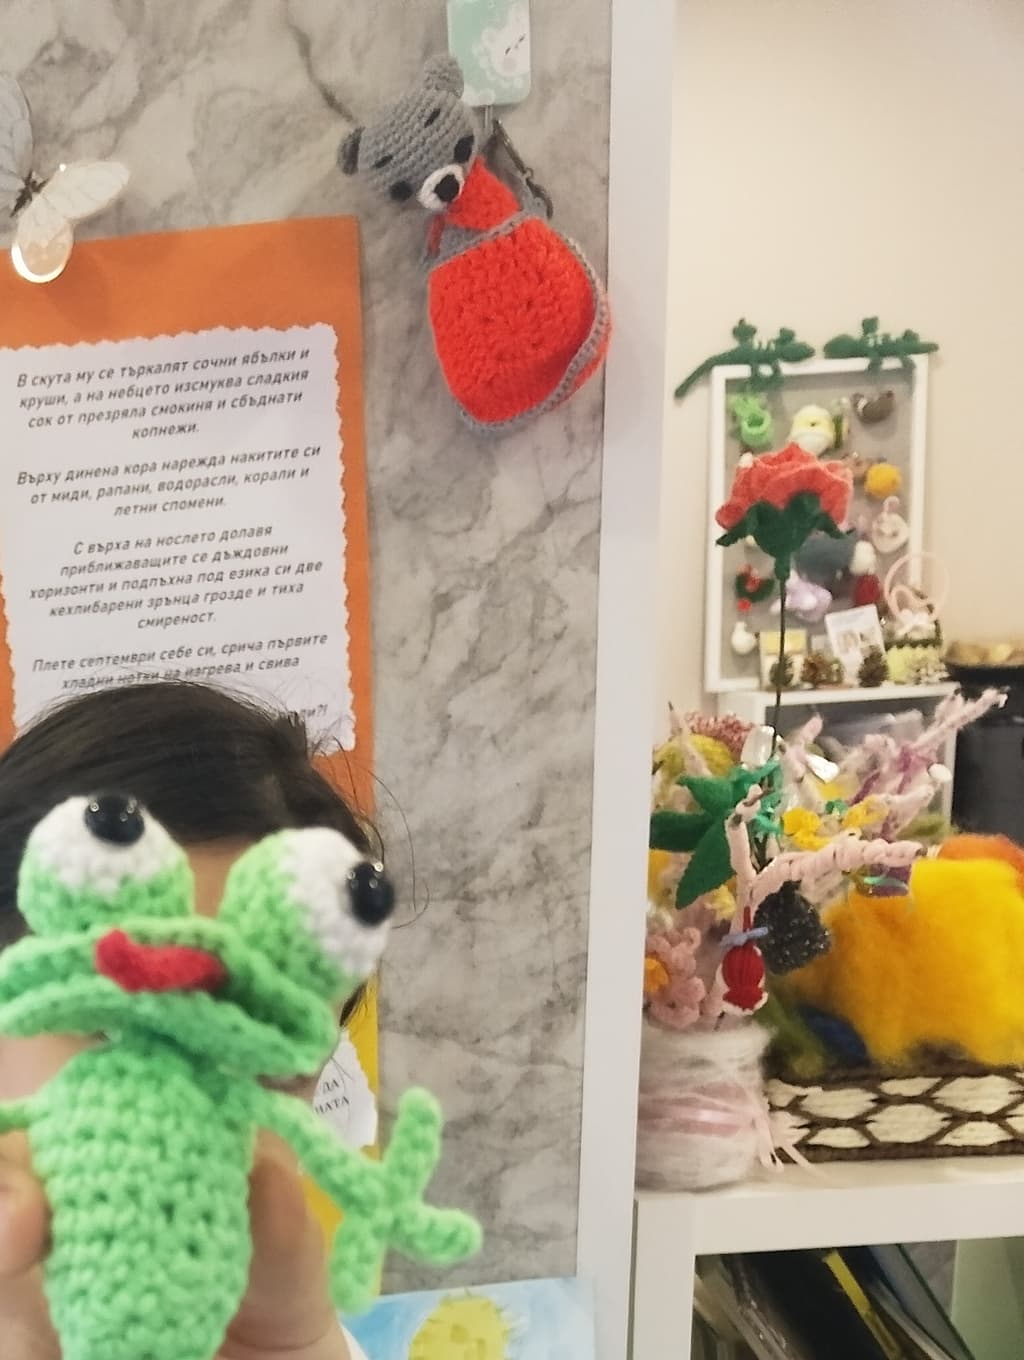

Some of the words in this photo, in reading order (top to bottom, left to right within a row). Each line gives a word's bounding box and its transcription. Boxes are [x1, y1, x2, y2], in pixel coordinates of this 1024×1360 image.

[16, 372, 27, 387] В
[30, 372, 72, 388] скута
[75, 370, 95, 384] му
[97, 368, 115, 379] се
[119, 360, 188, 379] търкалят
[192, 356, 237, 370] сочни
[241, 349, 296, 365] ябълки
[299, 349, 309, 359] и
[19, 394, 70, 411] круши,
[73, 392, 82, 403] а
[85, 390, 104, 401] на
[107, 383, 170, 400] небцето
[174, 376, 242, 393] изсмуква
[246, 370, 309, 386] сладкия
[27, 416, 52, 428] сок
[56, 414, 73, 425] от
[77, 407, 146, 426] презряла
[150, 400, 213, 416] смокиня
[216, 399, 226, 410] и
[230, 392, 302, 409] сбъднати
[131, 423, 199, 438] копнежи.
[16, 471, 61, 487] Върху
[64, 465, 119, 484] динена
[123, 461, 157, 476] кора
[161, 454, 226, 472] нарежда
[230, 447, 299, 464] накитите
[302, 445, 321, 456] си
[29, 493, 47, 504] от
[50, 489, 92, 504] миди,
[95, 483, 154, 501] рапани,
[156, 474, 238, 494] водорасли,
[243, 468, 296, 485] корали
[299, 467, 309, 477] и
[113, 502, 157, 516] летни
[161, 496, 226, 512] спомени.
[72, 540, 83, 555] С
[86, 540, 130, 555] върха
[134, 537, 152, 549] на
[155, 531, 216, 547] нослето
[218, 525, 272, 544] долавя
[59, 554, 187, 579] приближаващите
[191, 552, 208, 563] се
[211, 544, 288, 565] дъждовни
[29, 582, 104, 601] хоризонти
[107, 581, 118, 591] и
[121, 574, 193, 592] подпъхна
[196, 571, 224, 585] под
[228, 566, 270, 580] езика
[273, 564, 291, 576] си
[294, 561, 322, 577] две
[49, 599, 143, 618] кехлибарени
[146, 593, 200, 611] зрънца
[202, 588, 253, 605] грозде
[256, 586, 266, 597] и
[271, 582, 304, 595] тиха
[137, 611, 216, 630] смиреност.
[32, 657, 76, 672] Плете
[78, 650, 156, 667] септември
[159, 644, 193, 660] себе
[196, 645, 218, 658] си,
[220, 640, 263, 657] срича
[266, 634, 327, 651] първите
[62, 675, 114, 690] хладни
[184, 662, 241, 679] изгрева
[244, 661, 254, 672] и
[257, 657, 299, 670] свива
